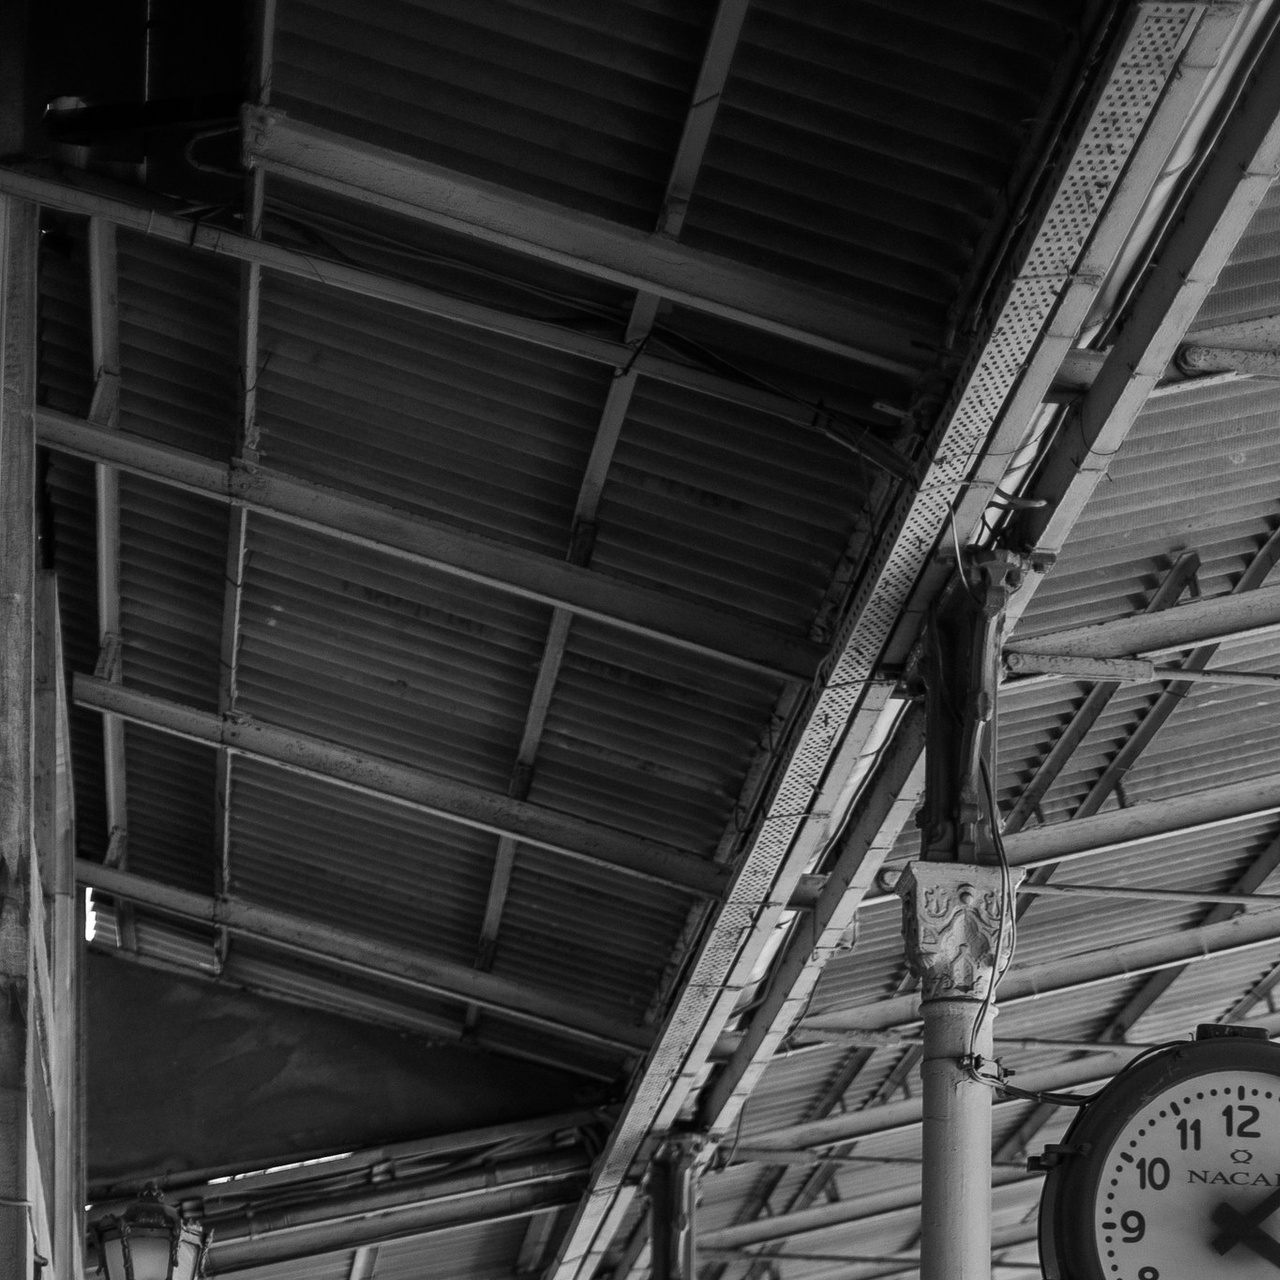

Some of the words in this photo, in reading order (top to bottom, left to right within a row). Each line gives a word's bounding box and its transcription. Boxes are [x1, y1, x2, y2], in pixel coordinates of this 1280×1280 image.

[1176, 1118, 1202, 1151] 11
[1221, 1104, 1261, 1138] 12
[1135, 1157, 1171, 1190] 10
[1120, 1210, 1146, 1244] 9
